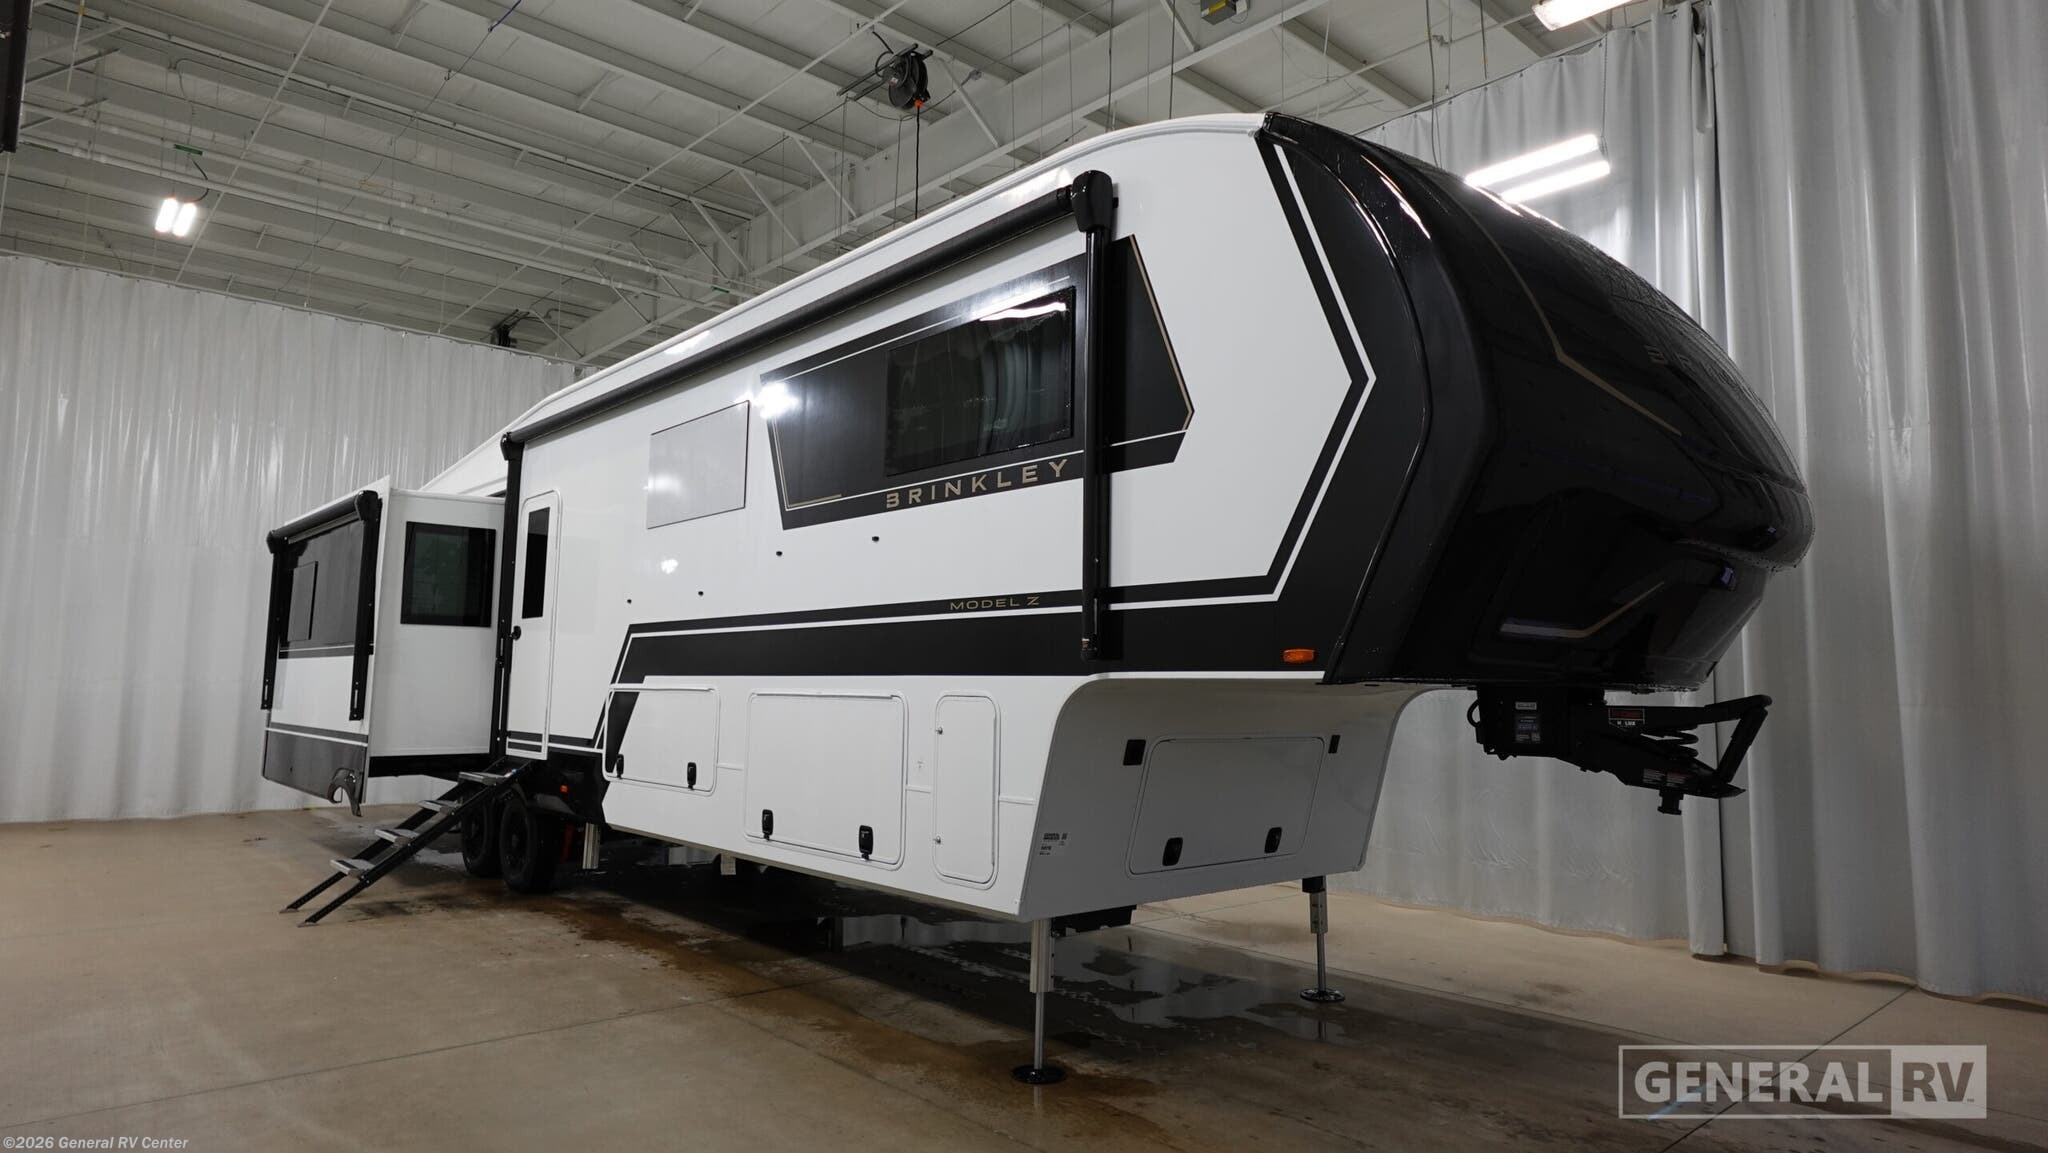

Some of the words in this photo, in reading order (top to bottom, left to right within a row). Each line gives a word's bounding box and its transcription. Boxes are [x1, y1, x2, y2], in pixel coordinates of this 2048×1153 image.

[886, 459, 1068, 508] BRINKLEY
[950, 597, 1020, 611] MODEL
[1026, 596, 1041, 607] Z
